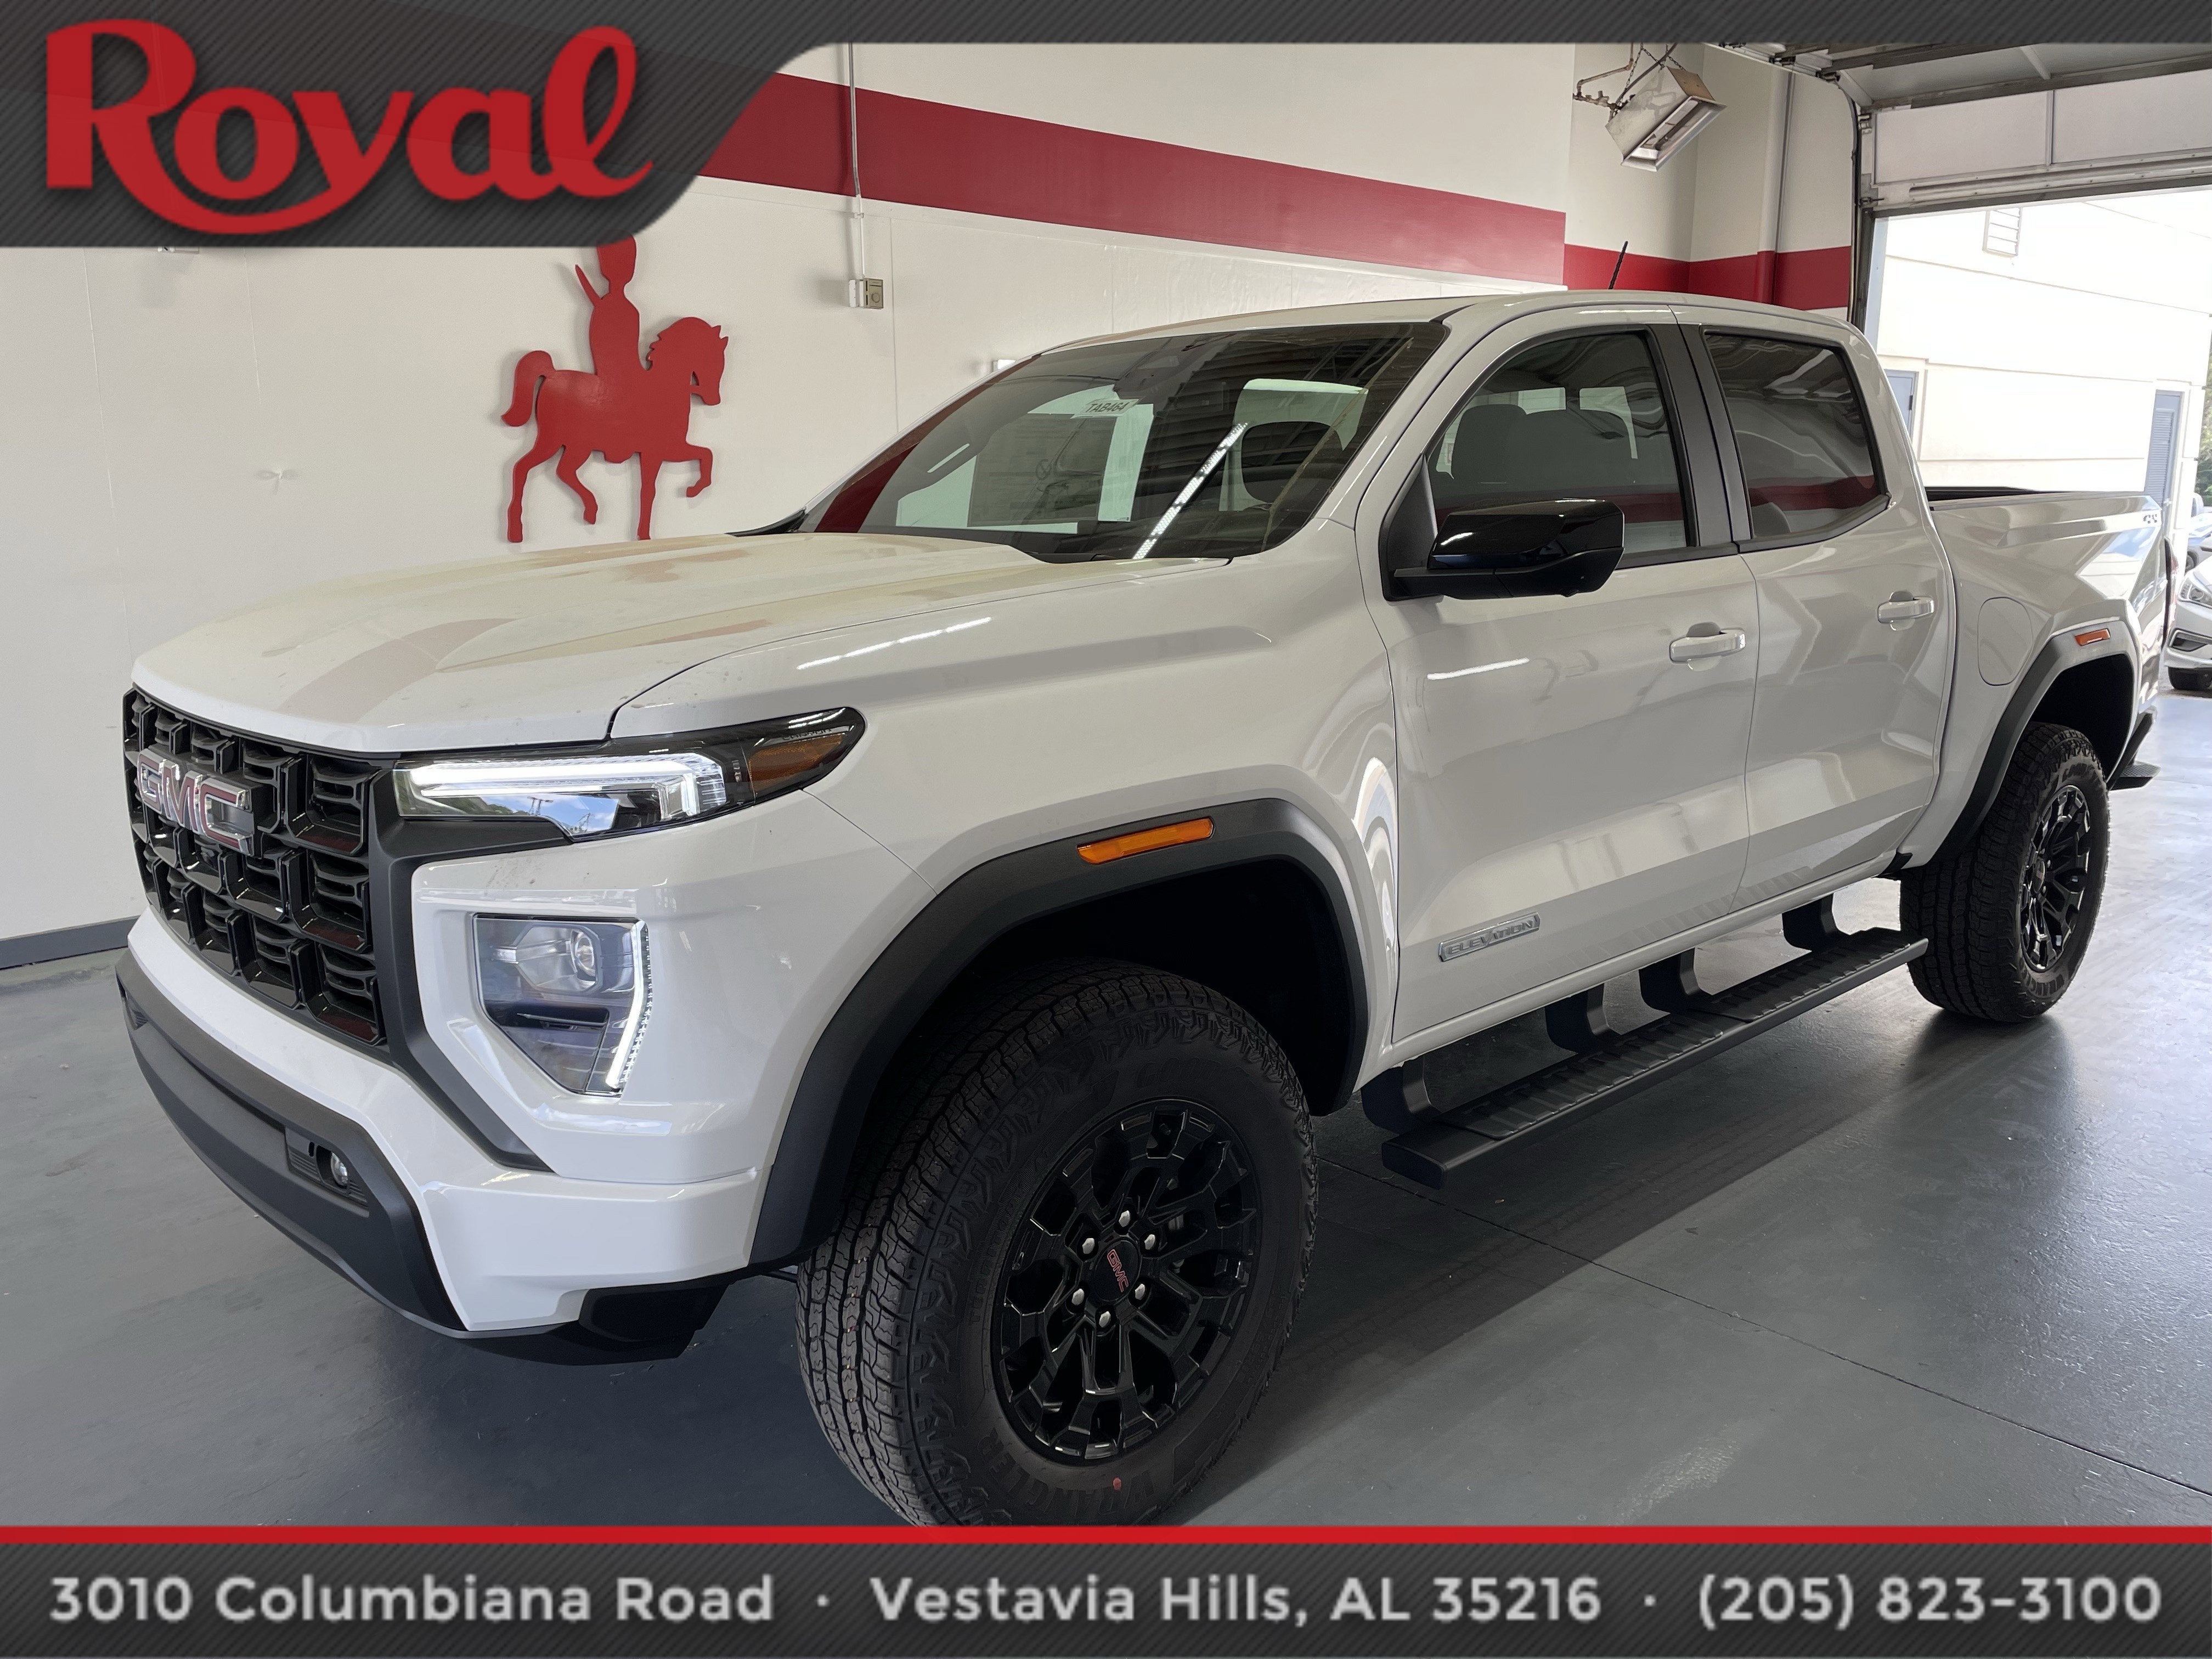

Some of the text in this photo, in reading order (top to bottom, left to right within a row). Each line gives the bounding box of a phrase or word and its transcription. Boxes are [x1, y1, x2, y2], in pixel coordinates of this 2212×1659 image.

[1086, 402, 1130, 413] TAB464
[137, 748, 253, 856] GMC
[1107, 1249, 1129, 1293] GMC
